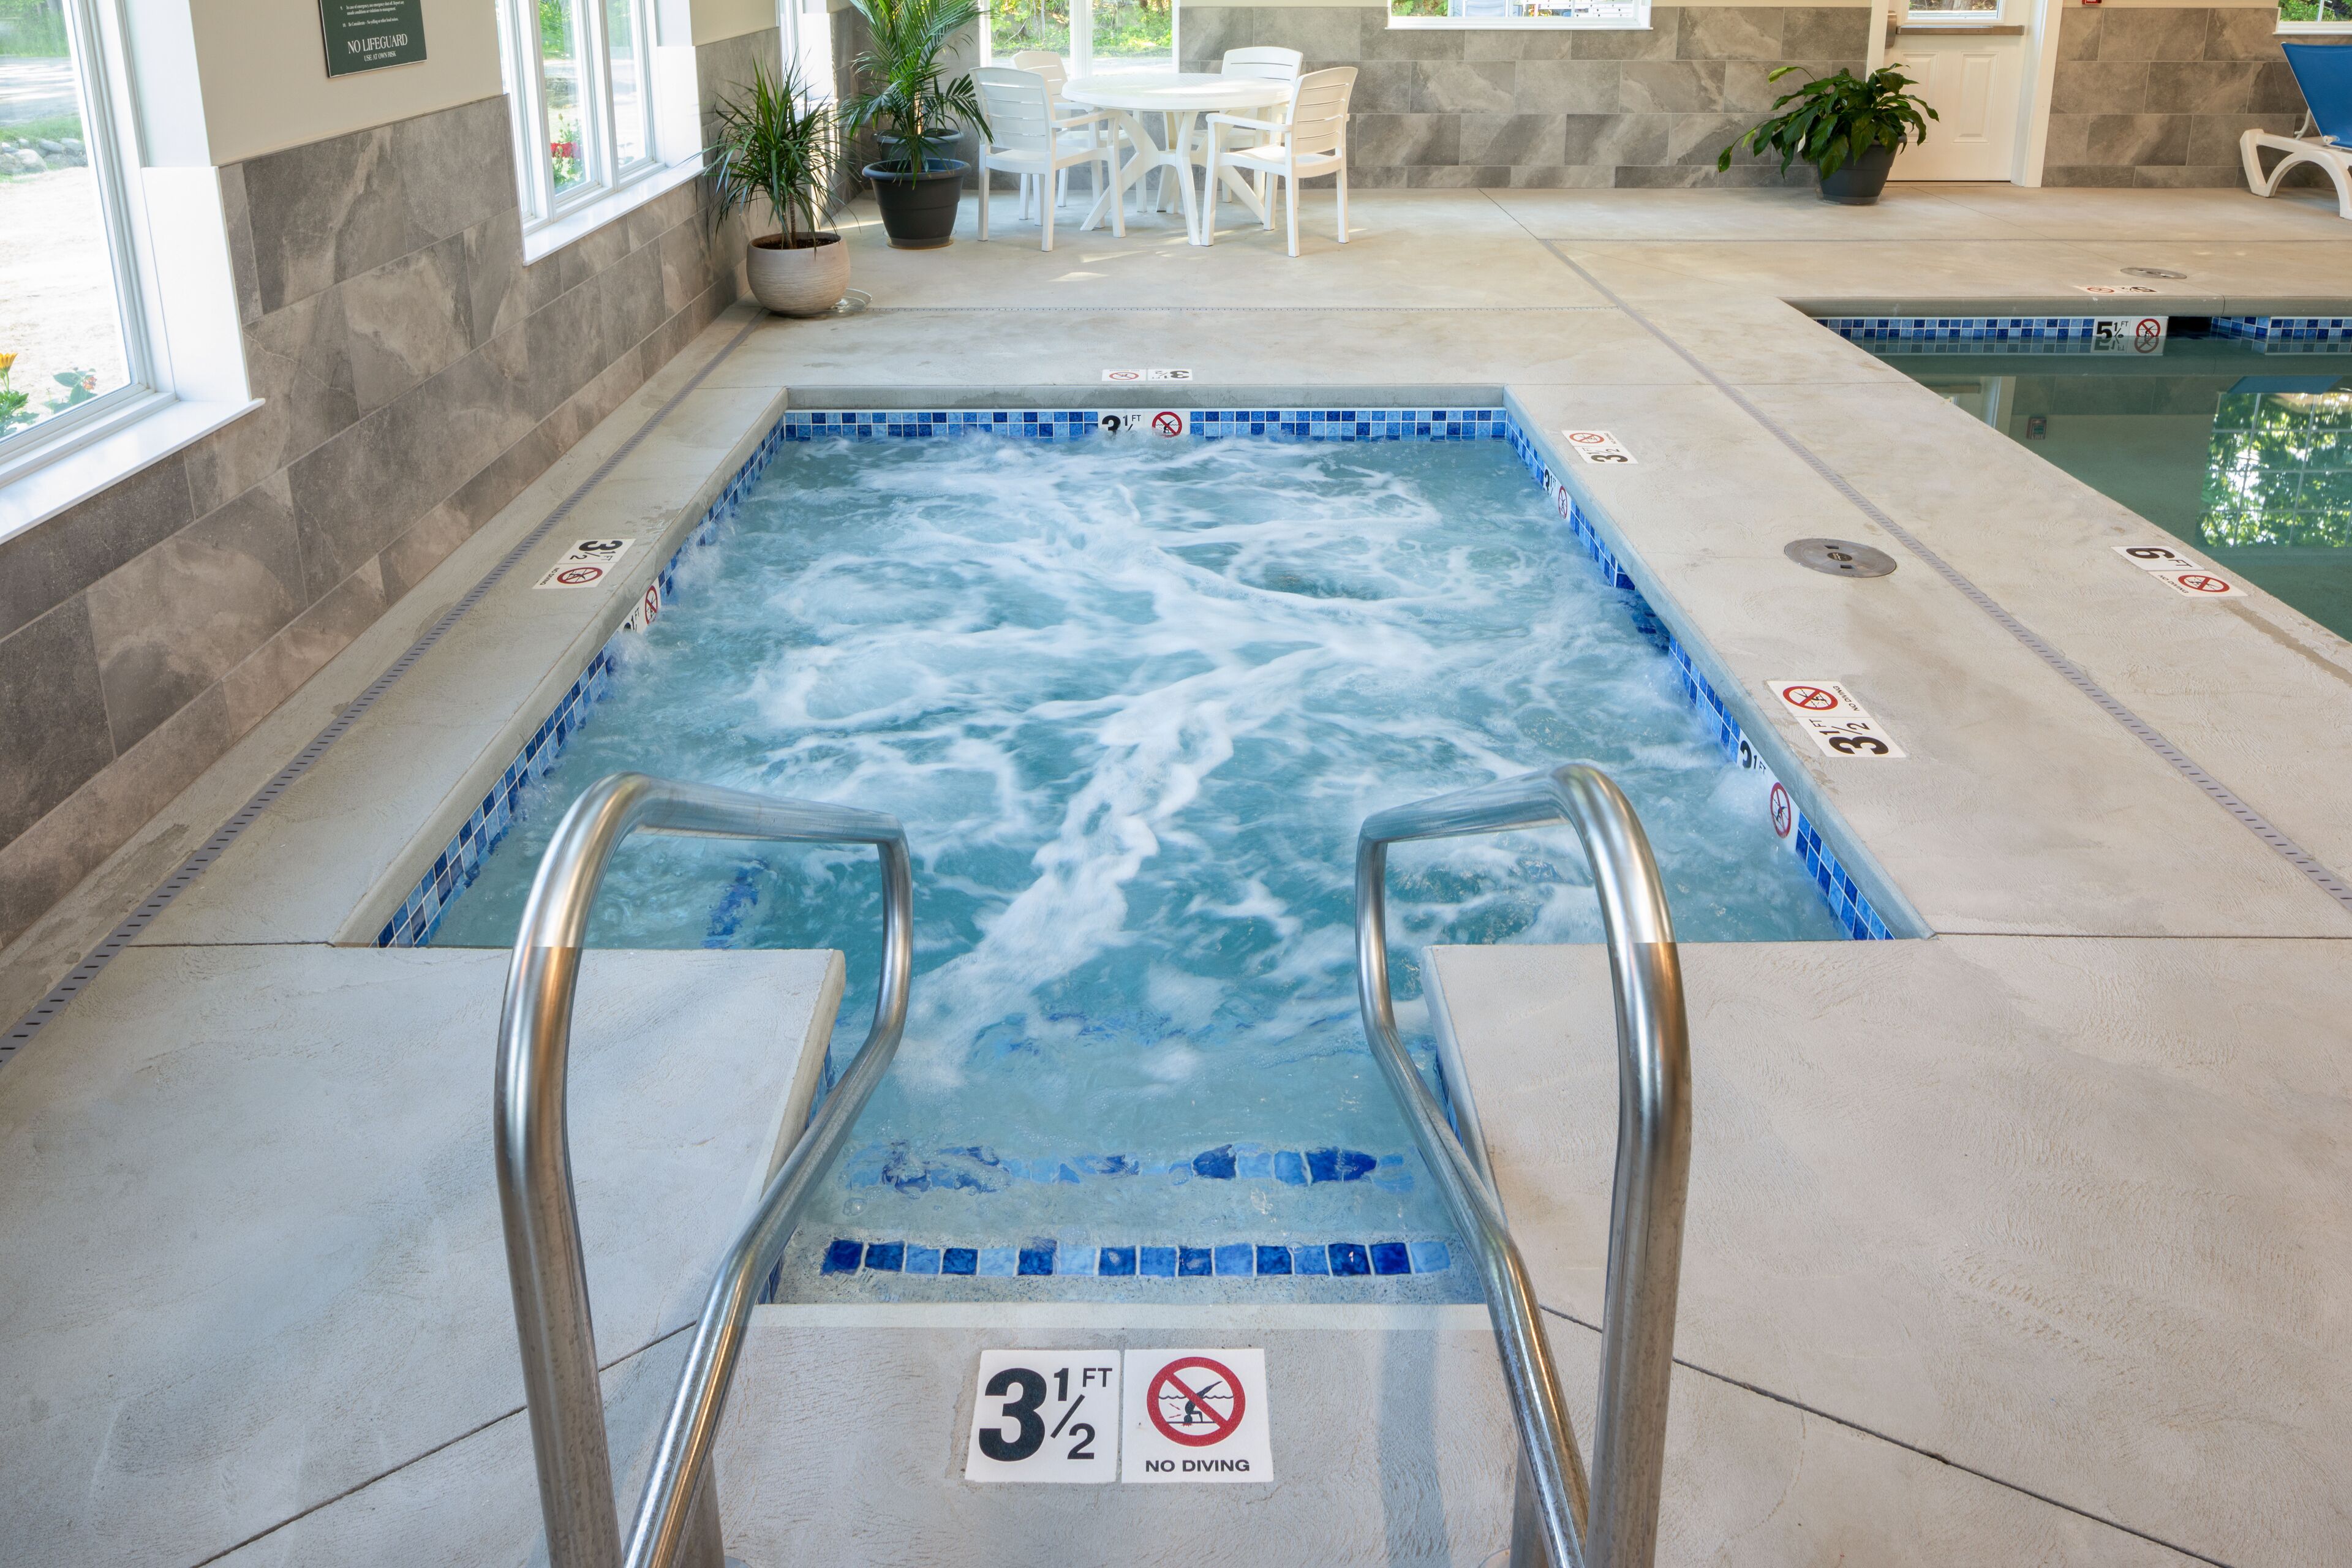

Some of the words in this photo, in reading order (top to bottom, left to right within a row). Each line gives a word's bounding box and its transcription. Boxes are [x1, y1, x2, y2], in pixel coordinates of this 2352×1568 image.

[347, 40, 361, 55] NO
[362, 33, 408, 51] LIFEGUARD
[2097, 321, 2113, 339] 5
[1170, 370, 1189, 379] 3
[578, 540, 624, 551] 3
[2126, 548, 2176, 559] 6
[2168, 559, 2193, 568] FT
[2167, 581, 2189, 594] DIVING
[1833, 685, 1852, 703] DIVING
[1849, 703, 1860, 711] NO
[1809, 719, 1826, 728] FT
[1828, 736, 1889, 755] 3
[1758, 761, 1766, 775] FT
[978, 1367, 1047, 1462] 3
[1082, 1367, 1114, 1388] FT
[1145, 1460, 1176, 1472] NO
[1182, 1458, 1251, 1473] DIVING
